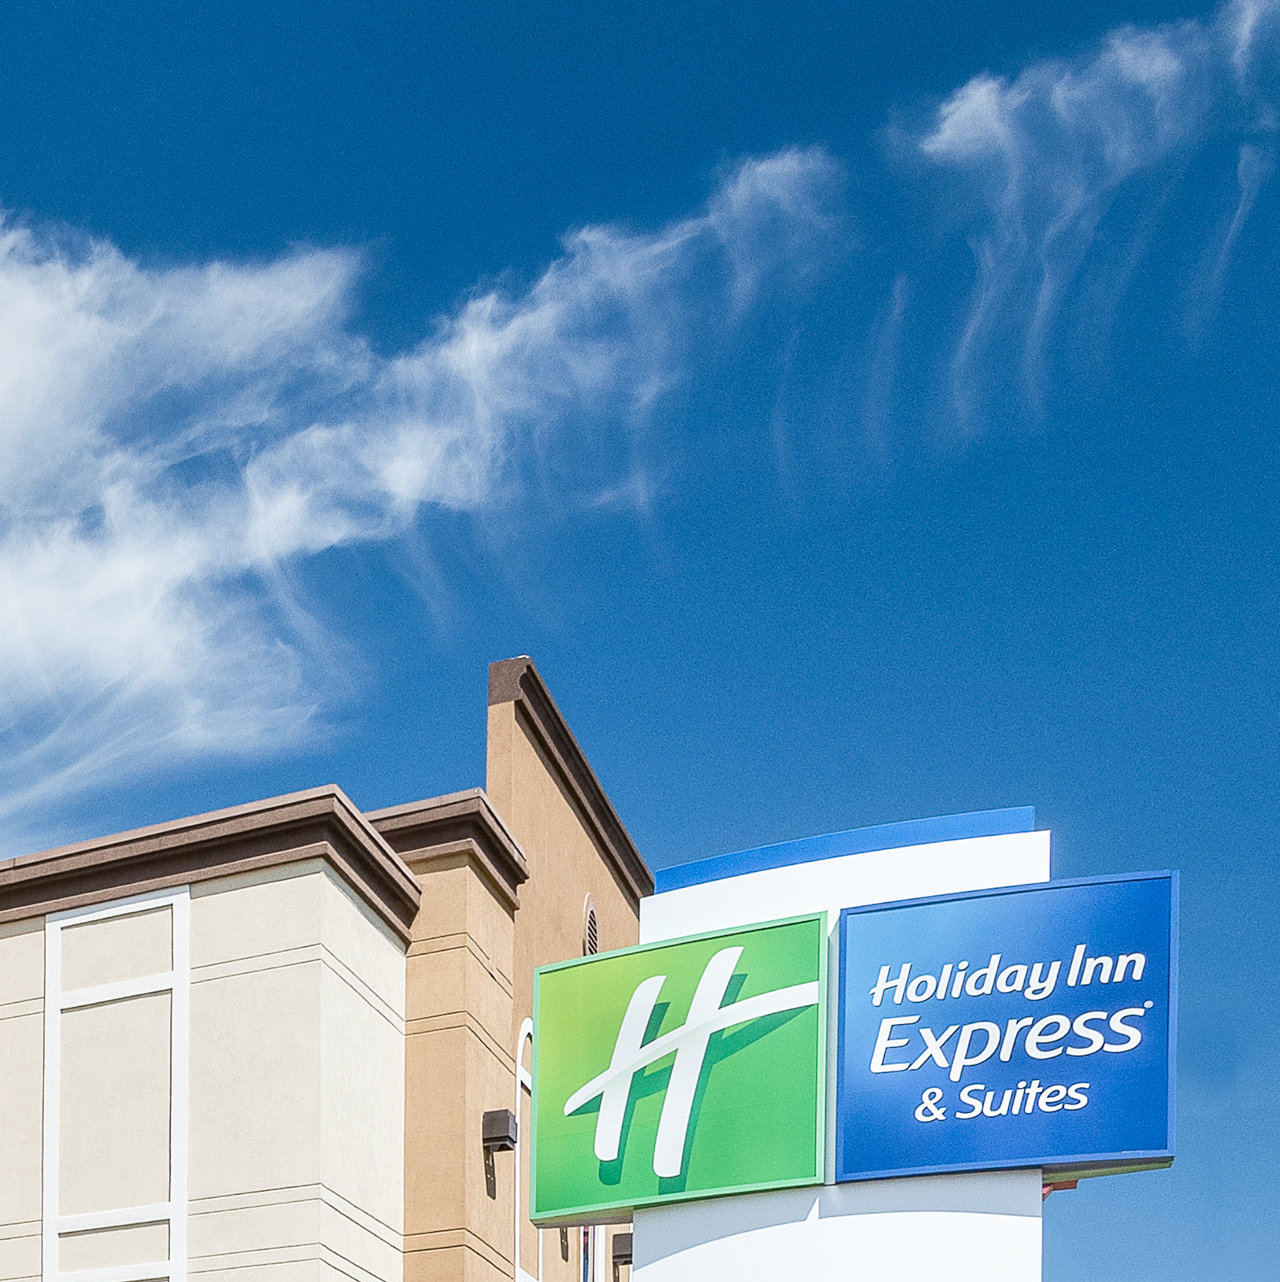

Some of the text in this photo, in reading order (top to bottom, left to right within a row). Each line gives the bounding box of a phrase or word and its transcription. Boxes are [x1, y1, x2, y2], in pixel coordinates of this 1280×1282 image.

[869, 944, 1146, 1006] Holiday Inn
[870, 1006, 1146, 1082] Express
[914, 1079, 1090, 1121] & Suites
